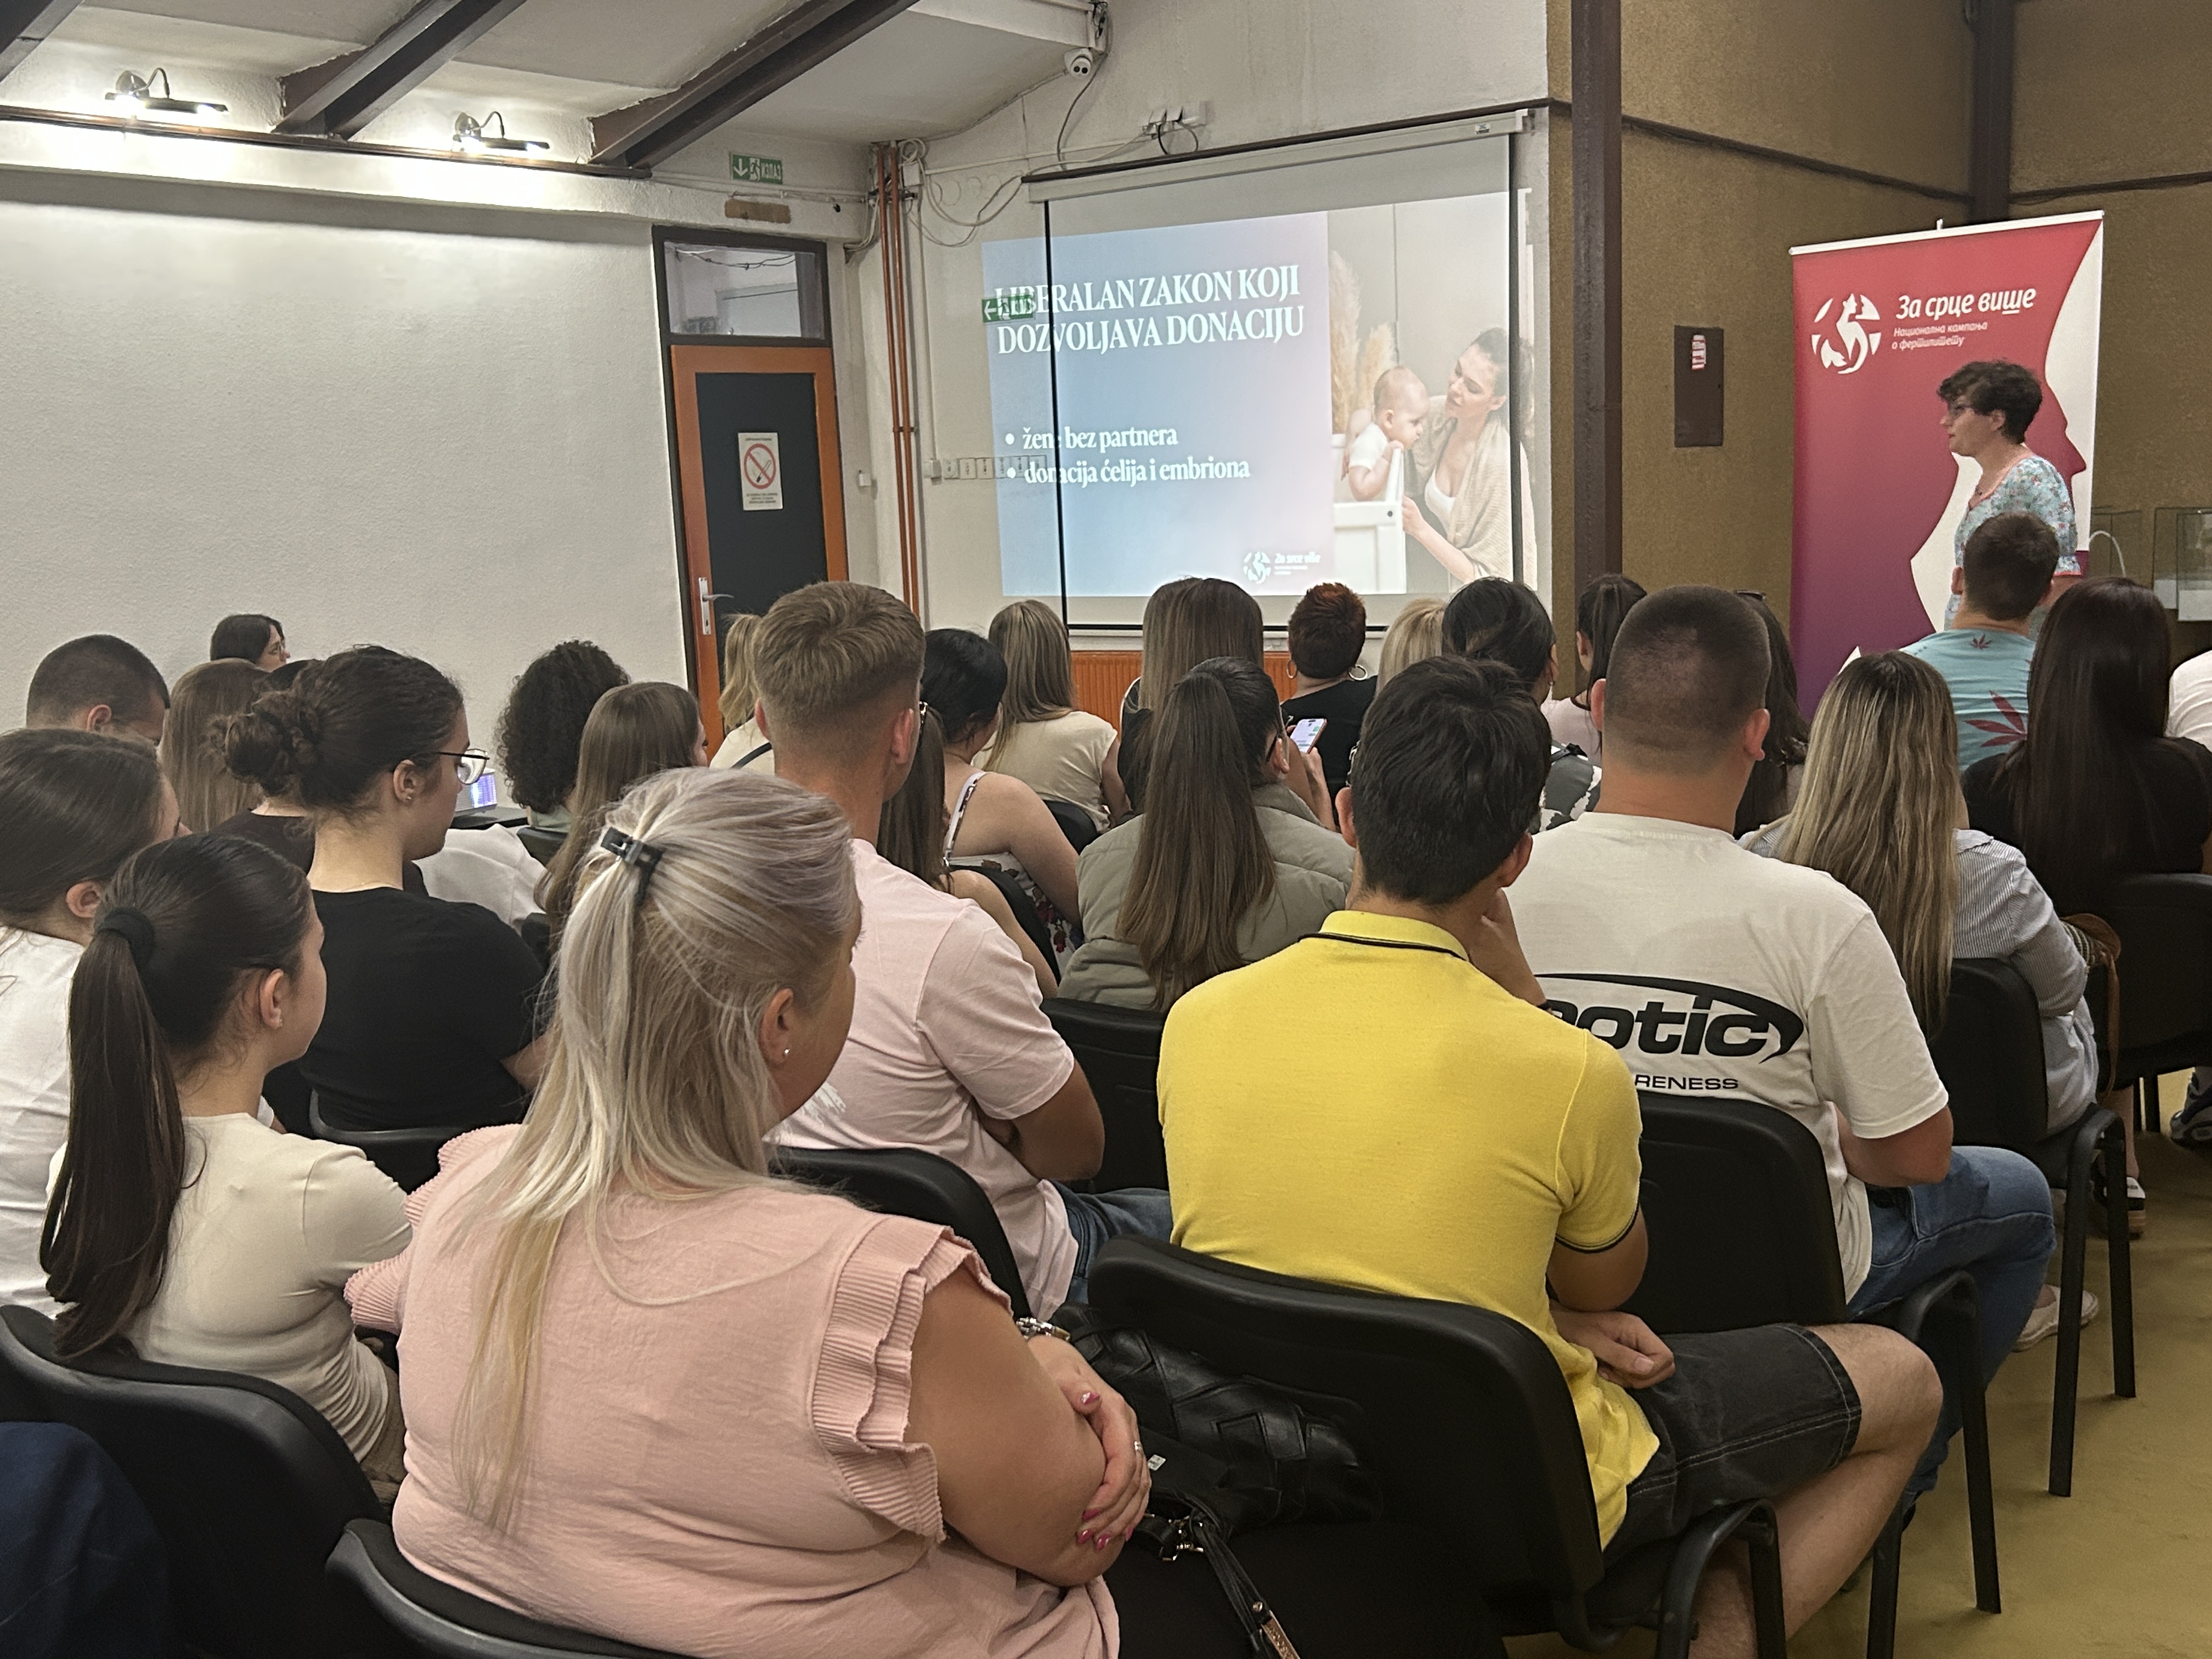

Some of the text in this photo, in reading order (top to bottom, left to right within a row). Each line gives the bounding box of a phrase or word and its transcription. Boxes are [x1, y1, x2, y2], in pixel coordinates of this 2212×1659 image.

[995, 279, 1135, 317] LIBERALAN
[1139, 271, 1232, 307] ZAKON
[1238, 264, 1300, 302] KOJI
[1895, 288, 2036, 320] За срце више
[997, 306, 1304, 355] DOZVOLJAVA DONACIJU
[1023, 426, 1178, 453] žen bez partnera
[1101, 459, 1147, 487] ćelija
[1150, 459, 1156, 481] i
[1160, 456, 1250, 480] embriona
[1635, 1074, 1739, 1090] RENESS
